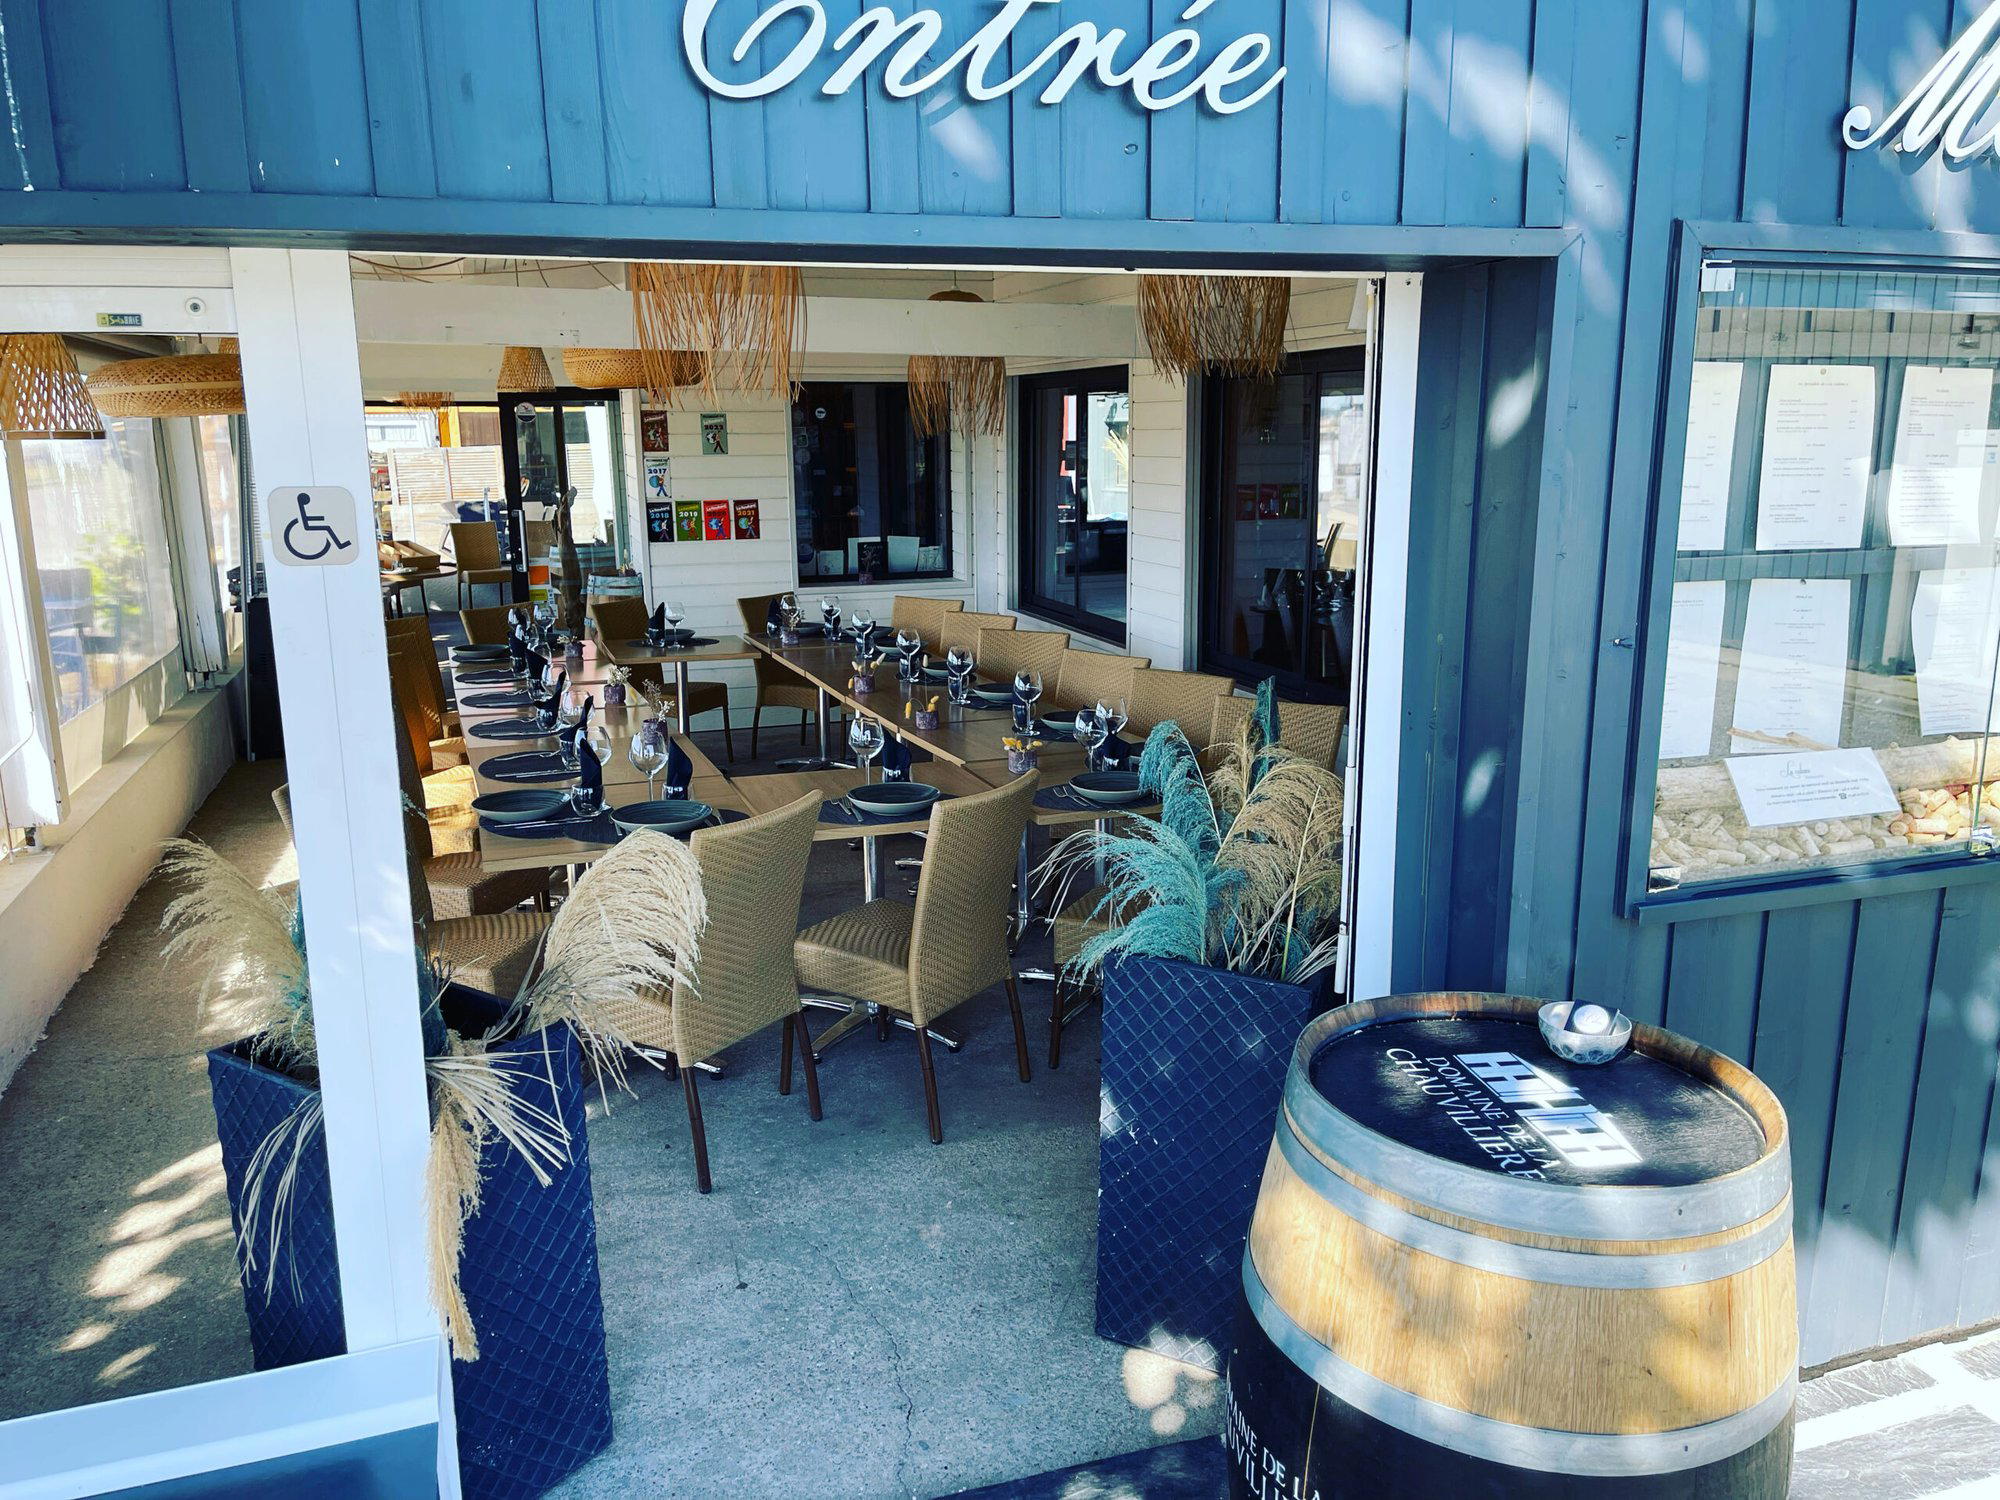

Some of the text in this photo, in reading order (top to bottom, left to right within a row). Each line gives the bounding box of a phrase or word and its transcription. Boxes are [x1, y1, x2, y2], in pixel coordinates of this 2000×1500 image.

[1386, 1047, 1546, 1180] CHAUVILLIERE
[1425, 1056, 1561, 1169] DOMAINE DE LA
[1262, 1446, 1286, 1488] DE
